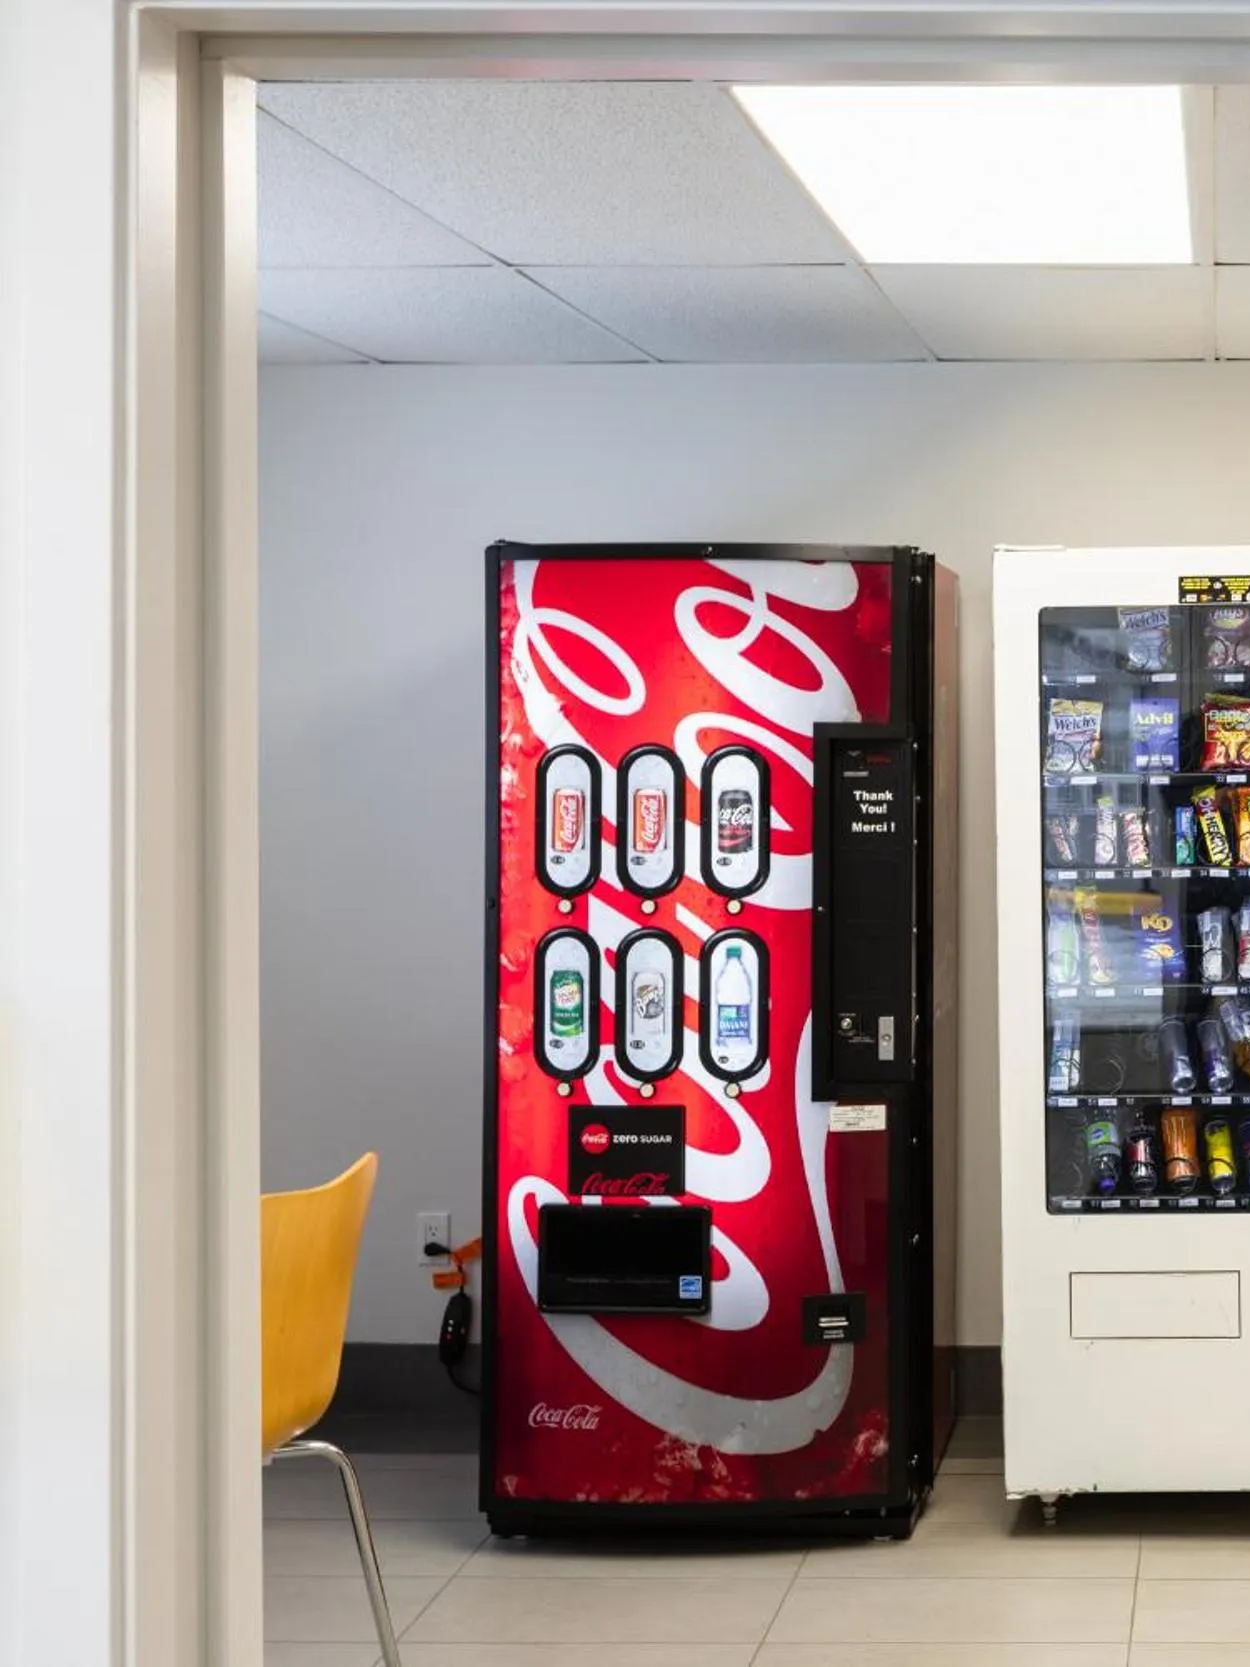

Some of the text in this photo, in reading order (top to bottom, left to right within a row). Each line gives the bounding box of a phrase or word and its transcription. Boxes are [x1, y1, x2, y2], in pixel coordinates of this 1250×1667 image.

[1054, 716, 1097, 732] Welch's
[1136, 712, 1174, 725] Advil
[852, 789, 894, 801] Thank
[860, 802, 888, 814] You!
[851, 821, 888, 833] Merci
[612, 1134, 639, 1144] zero
[639, 1134, 673, 1144] SUGAR
[527, 1401, 604, 1430] Coca-Cola
